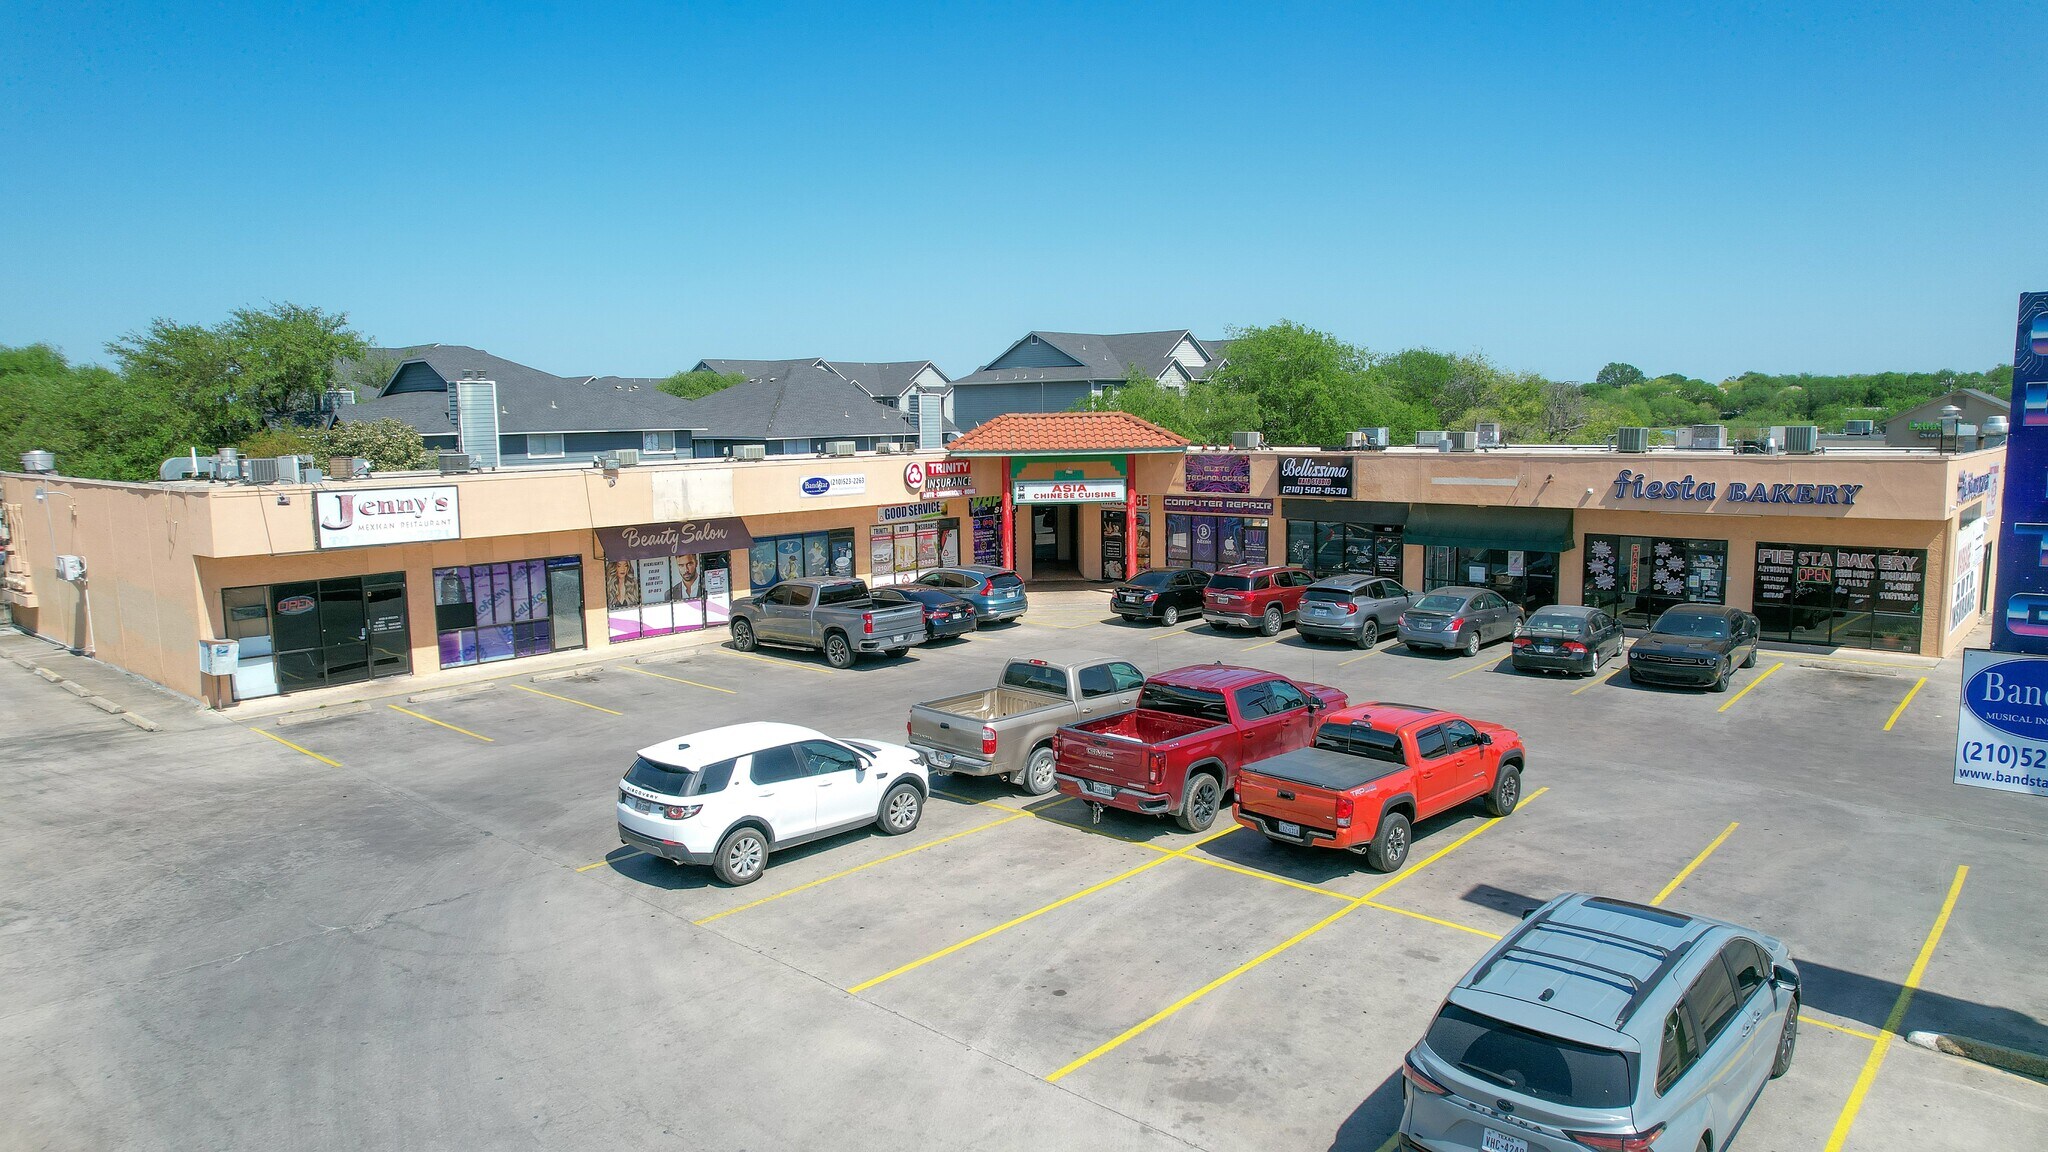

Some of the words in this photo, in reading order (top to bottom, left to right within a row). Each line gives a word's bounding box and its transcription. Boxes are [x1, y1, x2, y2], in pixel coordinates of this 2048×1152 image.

[929, 462, 969, 474] TRINITY
[1282, 458, 1349, 477] Bellissima
[927, 477, 972, 488] INSURANCE
[1186, 474, 1249, 482] TECHNOLOGIES
[1052, 484, 1087, 492] ASIA
[1305, 487, 1348, 495] 502-0530
[1614, 469, 1716, 501] fiesta
[1727, 483, 1863, 505] BAKERY
[884, 506, 907, 520] GOOD
[908, 501, 941, 516] SERVICE
[1165, 499, 1223, 507] COMPUTER
[1226, 501, 1272, 509] REPAIR
[321, 491, 449, 531] Jenny's
[622, 527, 679, 553] Beauty
[681, 522, 729, 545] Salon
[1757, 549, 1794, 564] FIE
[1798, 552, 1833, 566] STA
[1837, 552, 1876, 569] BAK
[1878, 554, 1919, 571] ERY
[1630, 545, 1639, 592] BAKERY
[1800, 568, 1830, 582] OPEN
[1838, 579, 1870, 588] DAILY
[277, 599, 315, 612] OPEN
[1982, 671, 2048, 707] Ban
[1986, 711, 2033, 724] MUSICAL
[1086, 747, 1114, 759] GMC
[1497, 1133, 1515, 1143] TEXAS
